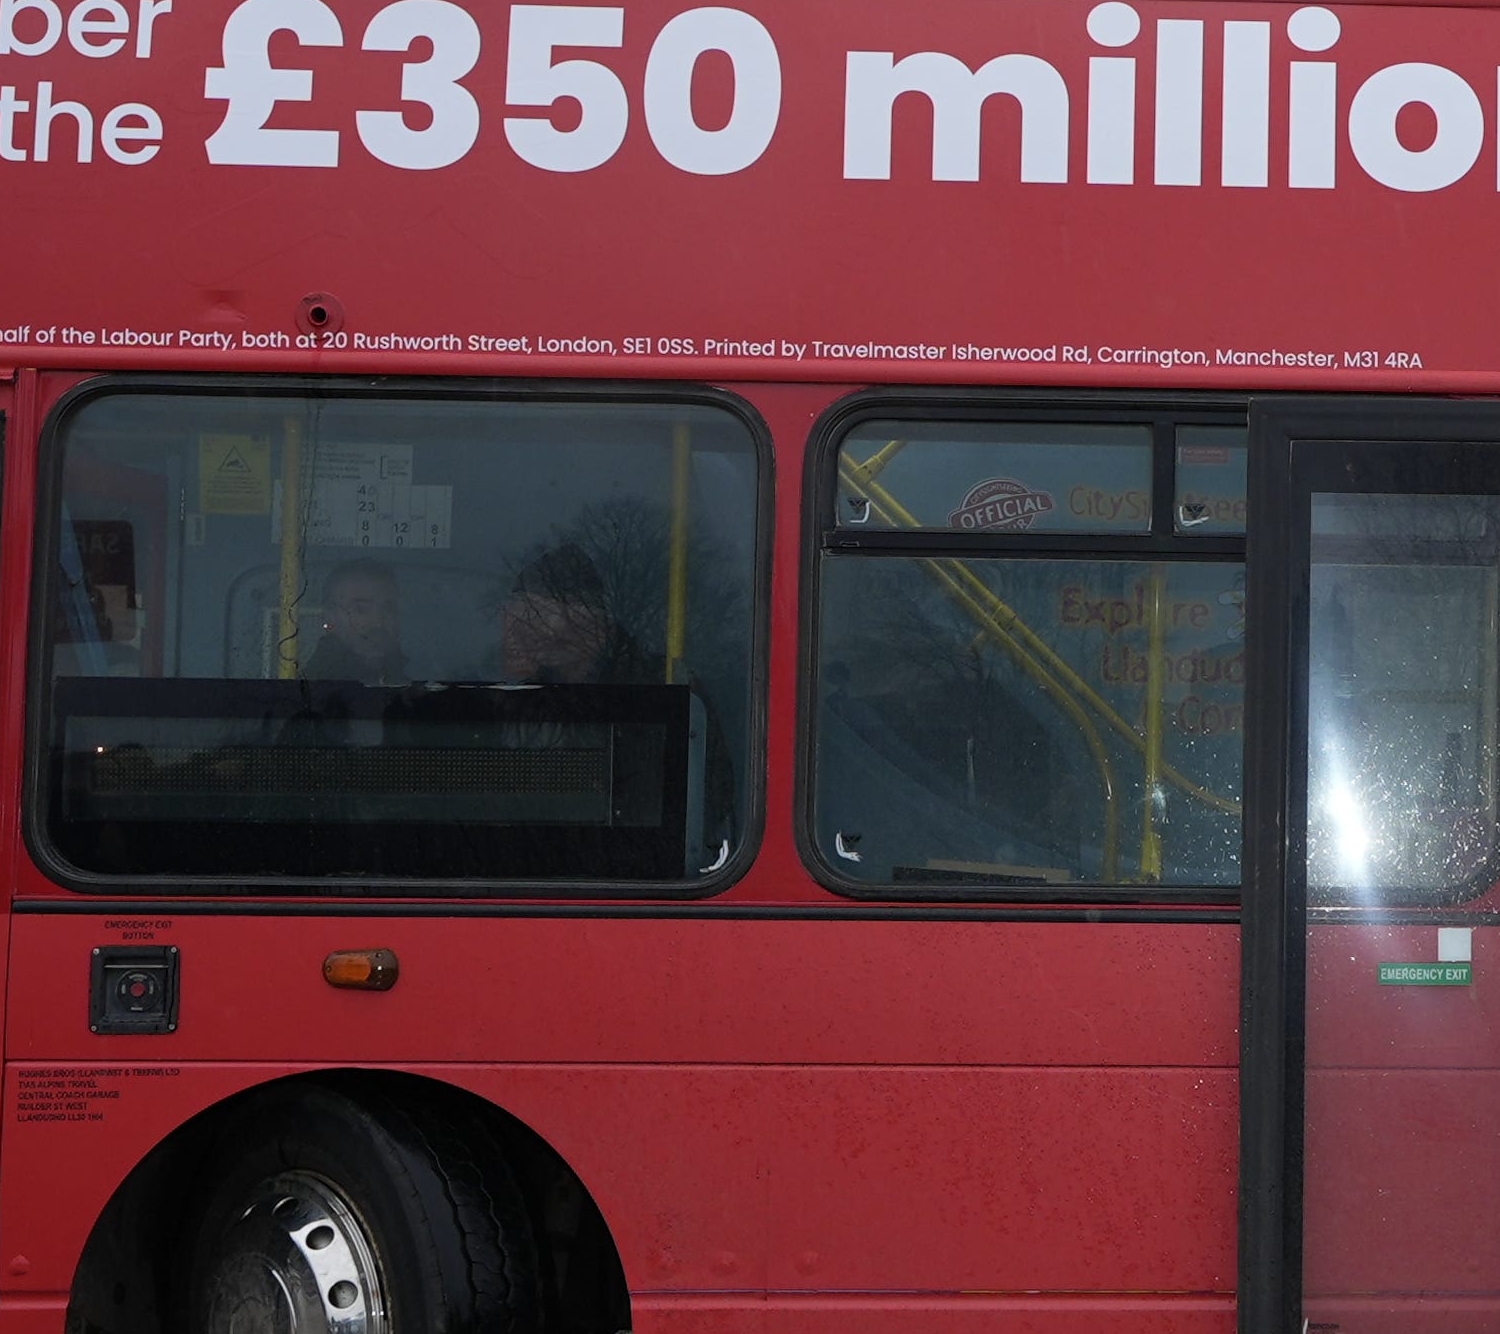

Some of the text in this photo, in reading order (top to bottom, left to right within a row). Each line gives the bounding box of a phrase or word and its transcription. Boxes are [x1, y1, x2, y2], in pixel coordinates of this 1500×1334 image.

[36, 325, 57, 344] of
[62, 327, 96, 345] the
[102, 328, 173, 346] Labour
[179, 329, 236, 353] Party,
[242, 331, 289, 348] both
[296, 334, 317, 349] at
[323, 333, 348, 349] 20
[354, 333, 461, 351] Rushworth
[468, 335, 532, 355] Street,
[538, 336, 617, 357] London,
[623, 338, 652, 353] SE1
[658, 338, 698, 354] 0SS.
[705, 339, 775, 356] Printed
[782, 340, 807, 362] by
[812, 341, 947, 359] Travelmaster
[953, 344, 1056, 361] Isherwood
[1063, 346, 1093, 365] Rd,
[1098, 347, 1210, 369] Carrington,
[1216, 349, 1338, 370] Manchester,
[1344, 351, 1379, 368] M31
[1385, 352, 1423, 369] 4RA
[959, 495, 1050, 530] OFFICIAL
[1060, 584, 1211, 632] Explre
[1380, 967, 1469, 981] EMERGENCY EXIT
